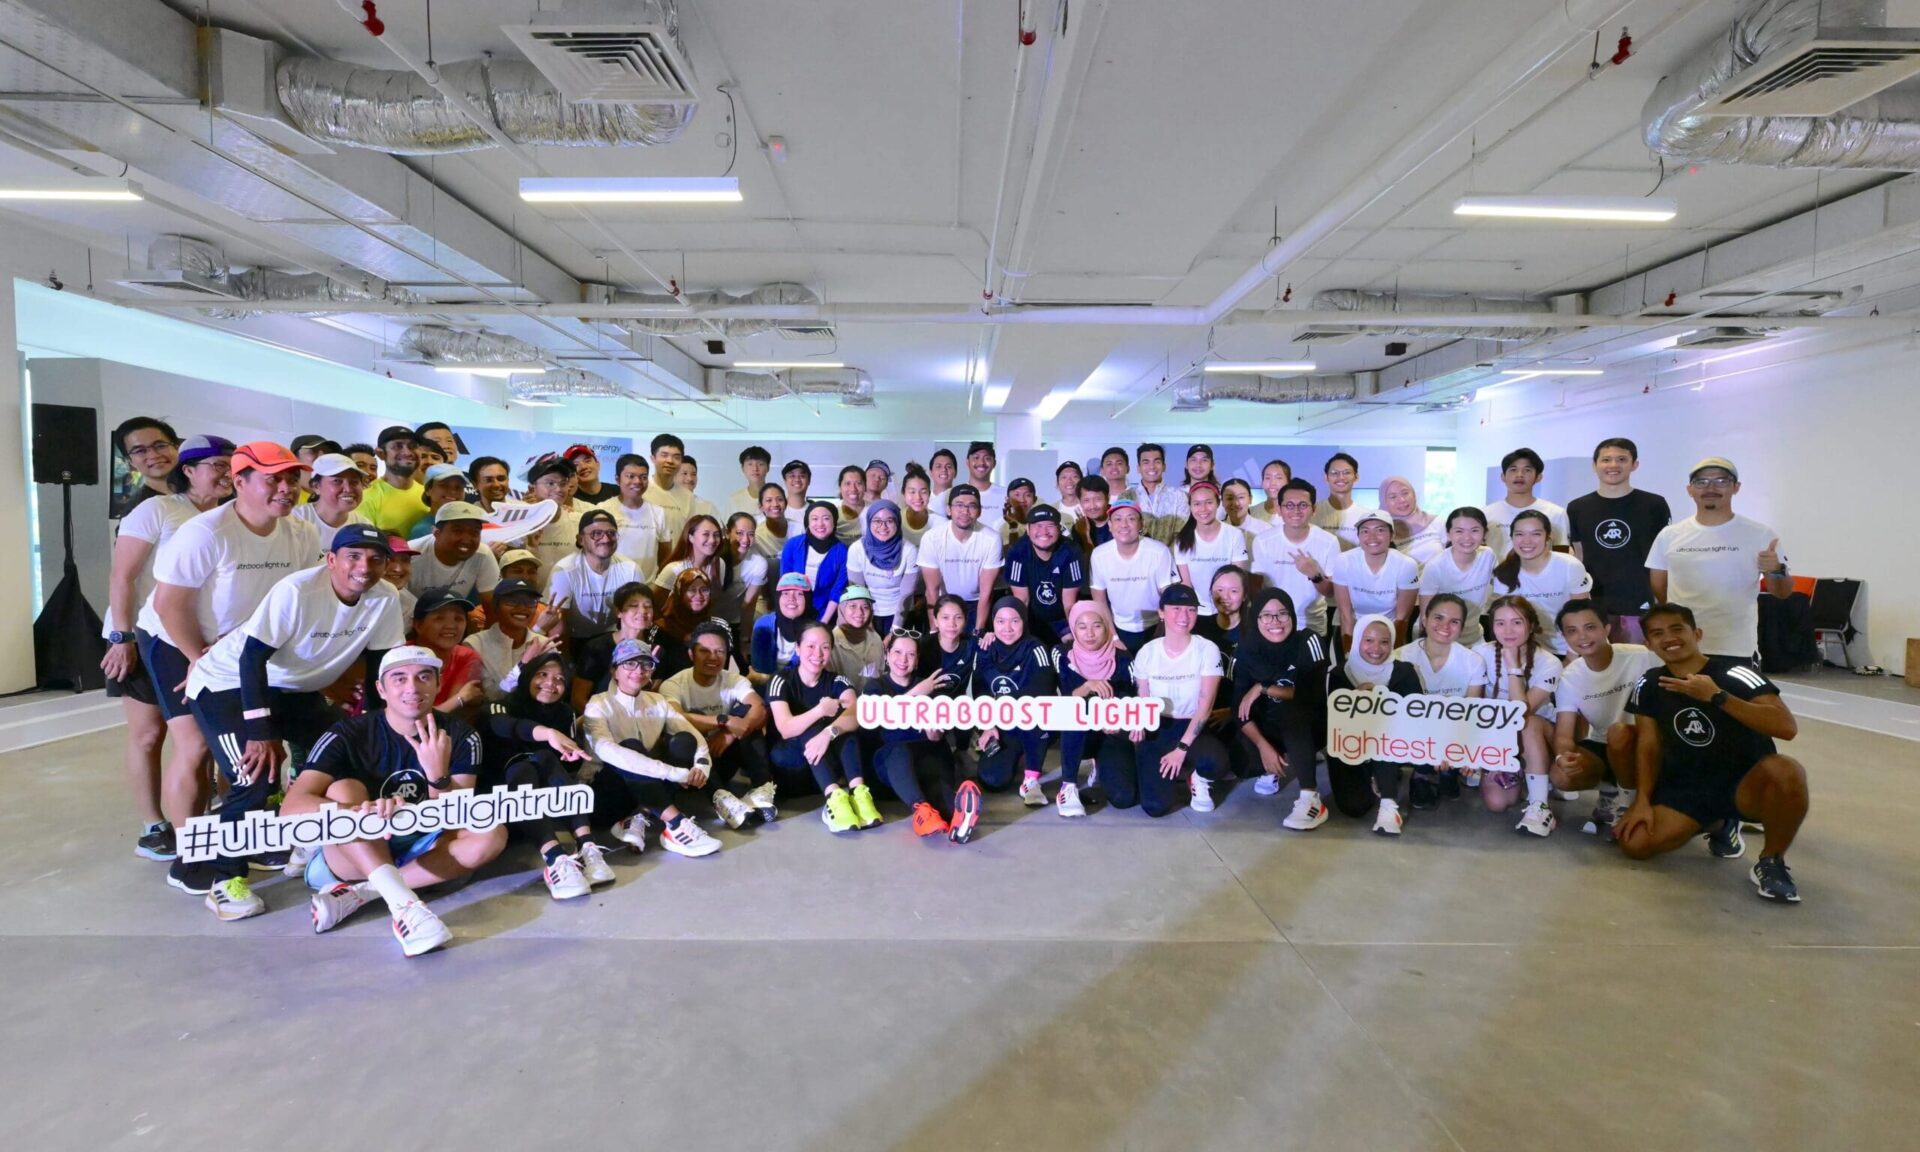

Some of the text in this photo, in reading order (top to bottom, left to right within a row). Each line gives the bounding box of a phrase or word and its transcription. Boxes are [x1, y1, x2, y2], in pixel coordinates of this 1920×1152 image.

[862, 701, 1159, 727] ULTRABOOST LIGHT
[1333, 691, 1519, 731] epic energy.
[1333, 728, 1515, 768] lightest ever.
[184, 788, 589, 857] #ultraboostlightrun
